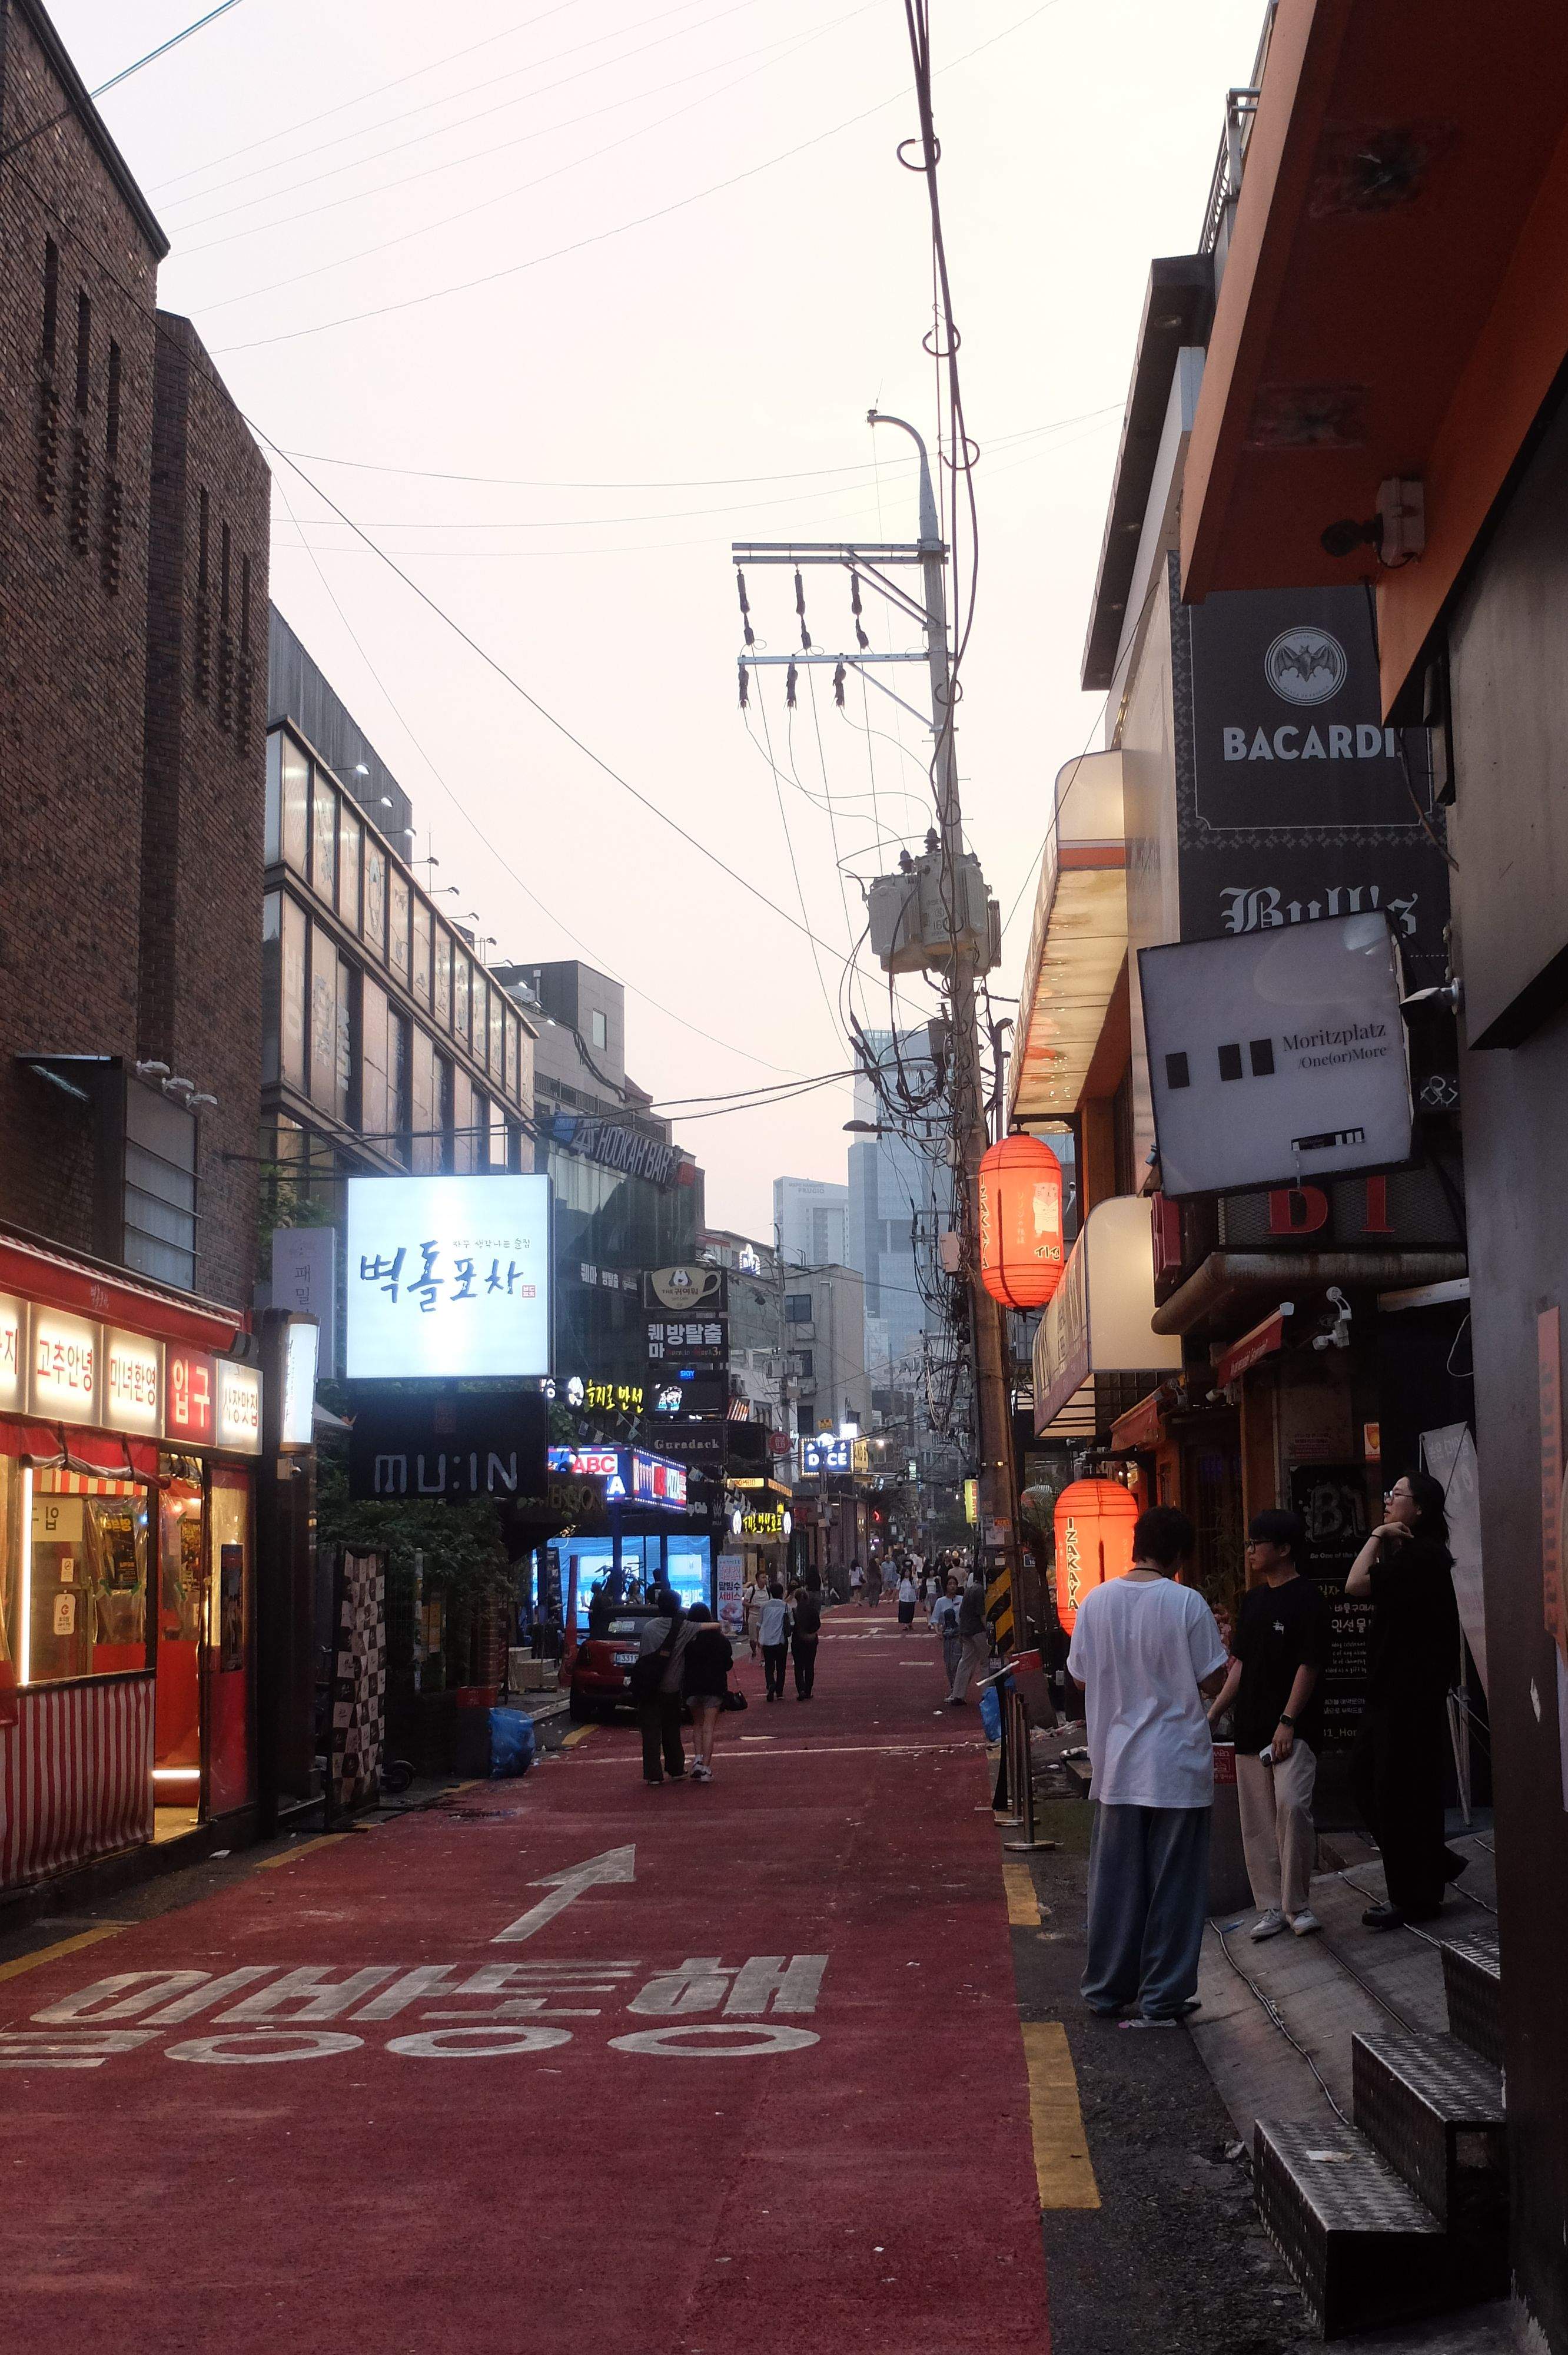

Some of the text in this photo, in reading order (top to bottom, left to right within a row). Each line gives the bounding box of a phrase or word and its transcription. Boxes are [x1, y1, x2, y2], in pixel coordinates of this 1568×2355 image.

[1223, 724, 1394, 761] BACARDI
[1283, 1023, 1386, 1052] Moritzplatz
[596, 1126, 646, 1175] HOOKAH
[645, 1140, 670, 1184] BAR
[474, 1239, 510, 1249] 생각나는
[514, 1238, 530, 1250] 술집
[295, 1264, 311, 1314] 패밀
[360, 1240, 524, 1313] 벽돌포차
[0, 1328, 19, 1375] 지
[666, 1323, 722, 1345] 방탈출
[37, 1340, 92, 1392] 고추안녕
[111, 1357, 155, 1405] 미녀환영
[173, 1358, 210, 1428] 입구
[573, 1455, 616, 1473] ABC
[808, 1452, 847, 1466] DCE
[1066, 1517, 1082, 1611] IZAKAYA
[719, 1591, 740, 1601] 서비스
